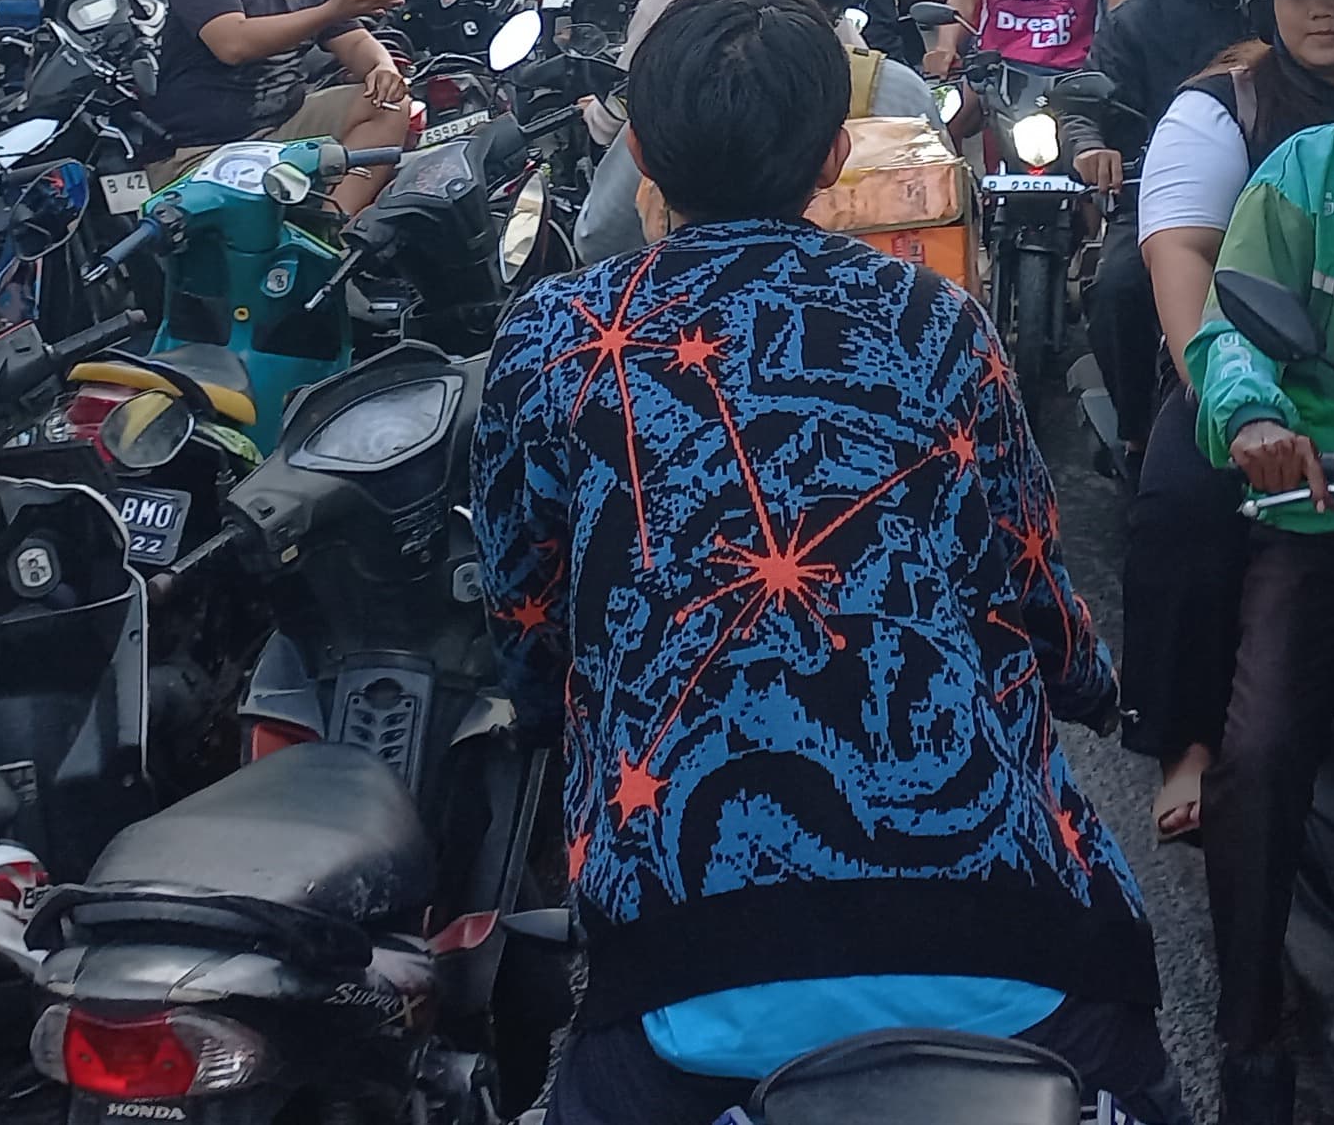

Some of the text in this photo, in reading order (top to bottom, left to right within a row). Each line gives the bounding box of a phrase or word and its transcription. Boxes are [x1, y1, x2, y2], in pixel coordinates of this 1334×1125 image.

[1031, 21, 1072, 48] Lab
[107, 178, 119, 194] B
[130, 535, 164, 554] 22
[107, 1101, 187, 1121] HONDA
